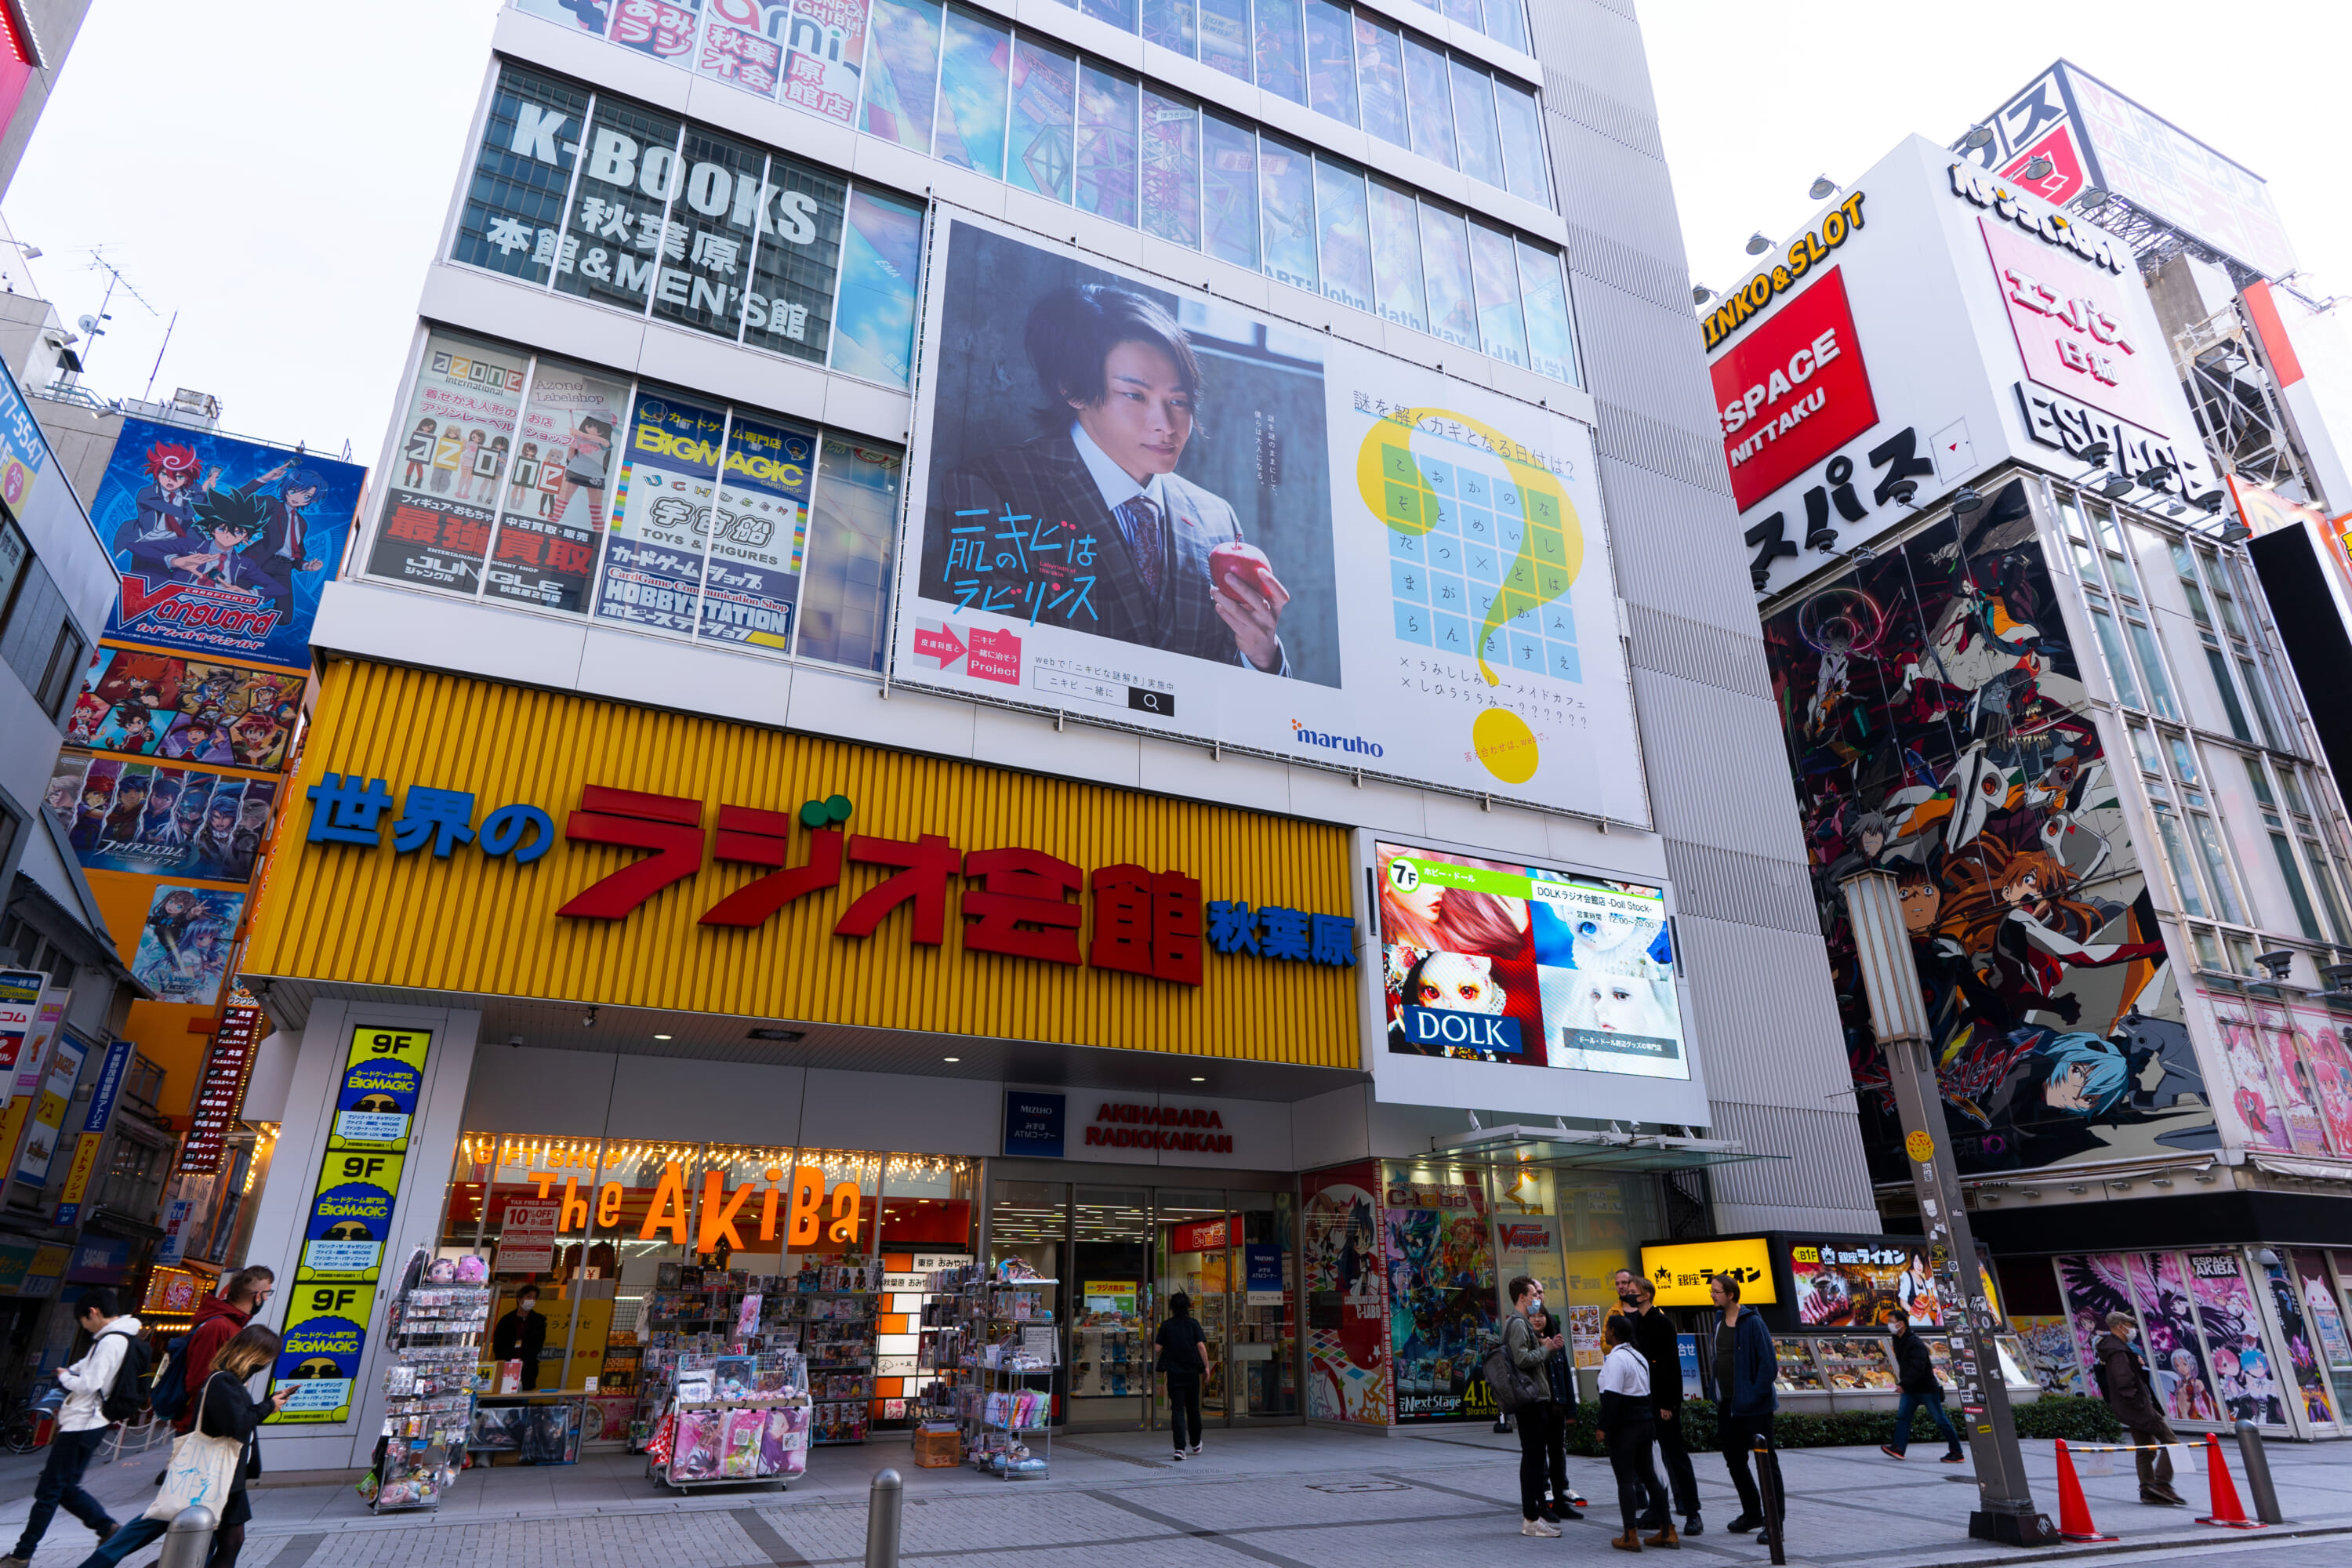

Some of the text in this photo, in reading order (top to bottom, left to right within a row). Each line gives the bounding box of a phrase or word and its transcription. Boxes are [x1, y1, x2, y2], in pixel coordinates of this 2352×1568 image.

[510, 102, 818, 245] K-BOOKS
[580, 194, 742, 277] 秋葉原
[486, 216, 808, 343] 本館&MEN'S館
[1701, 275, 1772, 353] INKO
[1788, 191, 1865, 282] SLOT
[2005, 268, 2135, 355] エスパス
[431, 350, 524, 394] azone
[2056, 337, 2120, 387] 日拓
[445, 375, 504, 397] international
[535, 378, 583, 393] Azone
[422, 386, 557, 433] 着せかえ人形の お店
[536, 392, 604, 407] Labelshop
[420, 401, 575, 452] アゾンレーベル ショップ
[668, 412, 782, 450] カードゲーム専門店
[1352, 389, 1575, 481] 謎を解くカギとなる日付は?
[1730, 387, 1827, 468] NITTAKU
[2010, 381, 2212, 504] ESPACE
[405, 431, 568, 496] azone
[634, 423, 804, 488] BIGMAGIC
[760, 478, 802, 495] CARD SHOP
[1744, 425, 1935, 557] スパス
[401, 493, 590, 548] フィギュア・おもちゃ 中古買取・販売
[649, 496, 775, 548] 宇宙船
[387, 504, 594, 575] 最強買取
[641, 527, 779, 565] TOYS & FIGURES
[951, 502, 1098, 573] ニキビは
[518, 563, 539, 574] SHOP
[611, 546, 763, 590] カードゲームショップ
[943, 538, 1018, 583] 肌の
[1039, 561, 1069, 573] Labyrinth
[1039, 567, 1048, 575] the
[404, 565, 455, 583] ジャングル
[405, 555, 564, 597] JUNGLE
[183, 586, 254, 604] CARDFIGHT!!
[608, 567, 672, 589] CardGame
[762, 598, 788, 614] Shop
[953, 576, 1098, 628] ラビリンス
[119, 573, 281, 638] Vanguard
[604, 579, 786, 634] HOBBYSTATION
[601, 601, 753, 641] ホビーステーション
[920, 637, 960, 654] 皮膚科医と
[972, 633, 997, 646] ニキビ
[971, 648, 1018, 664] 一緒に治そう
[971, 659, 1017, 678] Project
[1049, 677, 1114, 699] ニキビ 一緒に
[1516, 684, 1586, 709] メイドカフェ
[1296, 726, 1385, 759] maruho
[1464, 733, 1551, 764] 答え合わせは、webで。
[307, 771, 1361, 988] 世界の ラジオ会館 秋葉原
[1392, 864, 1417, 887] 7F
[1423, 867, 1476, 884] ホビー・ドール
[1536, 886, 1653, 913] DOLKラジオ会館店 -Doll Stock-
[1417, 1011, 1510, 1047] DOLK
[372, 1033, 412, 1055] 9F
[347, 1076, 416, 1092] BIGMAGIC
[355, 1070, 414, 1080] カードゲーム専門店
[1020, 1104, 1053, 1116] MIZUHO
[1096, 1103, 1224, 1130] AKIHABARA
[1014, 1129, 1057, 1140] ATMコーナー
[1025, 1122, 1046, 1131] みずほ
[1085, 1126, 1233, 1154] RADIOKAIKAN
[67, 1138, 96, 1200] カードラッシュ
[342, 1156, 386, 1178] 9F
[474, 1145, 624, 1170] GIFT SHOP
[317, 1203, 388, 1217] BIGMAGIC
[325, 1196, 387, 1205] カードゲーム専門店
[526, 1171, 624, 1234] The
[1386, 1189, 1468, 1208] C-labo
[510, 1208, 556, 1225] 10%OFF!
[1497, 1223, 1550, 1254] Vanguard
[917, 1256, 970, 1268] 東京 おみやげ
[1800, 1249, 1817, 1261] B1F
[1838, 1247, 1906, 1265] 銀座ライオン
[2192, 1256, 2234, 1265] ESPACE
[2196, 1263, 2238, 1276] AKIBA
[311, 1288, 357, 1312] 9F
[1356, 1305, 1381, 1319] C-LABO
[285, 1339, 359, 1354] BIGMAGIC
[292, 1330, 358, 1340] カードゲーム専門店
[1405, 1396, 1461, 1411] NextStage
[1465, 1406, 1490, 1416] Stand
